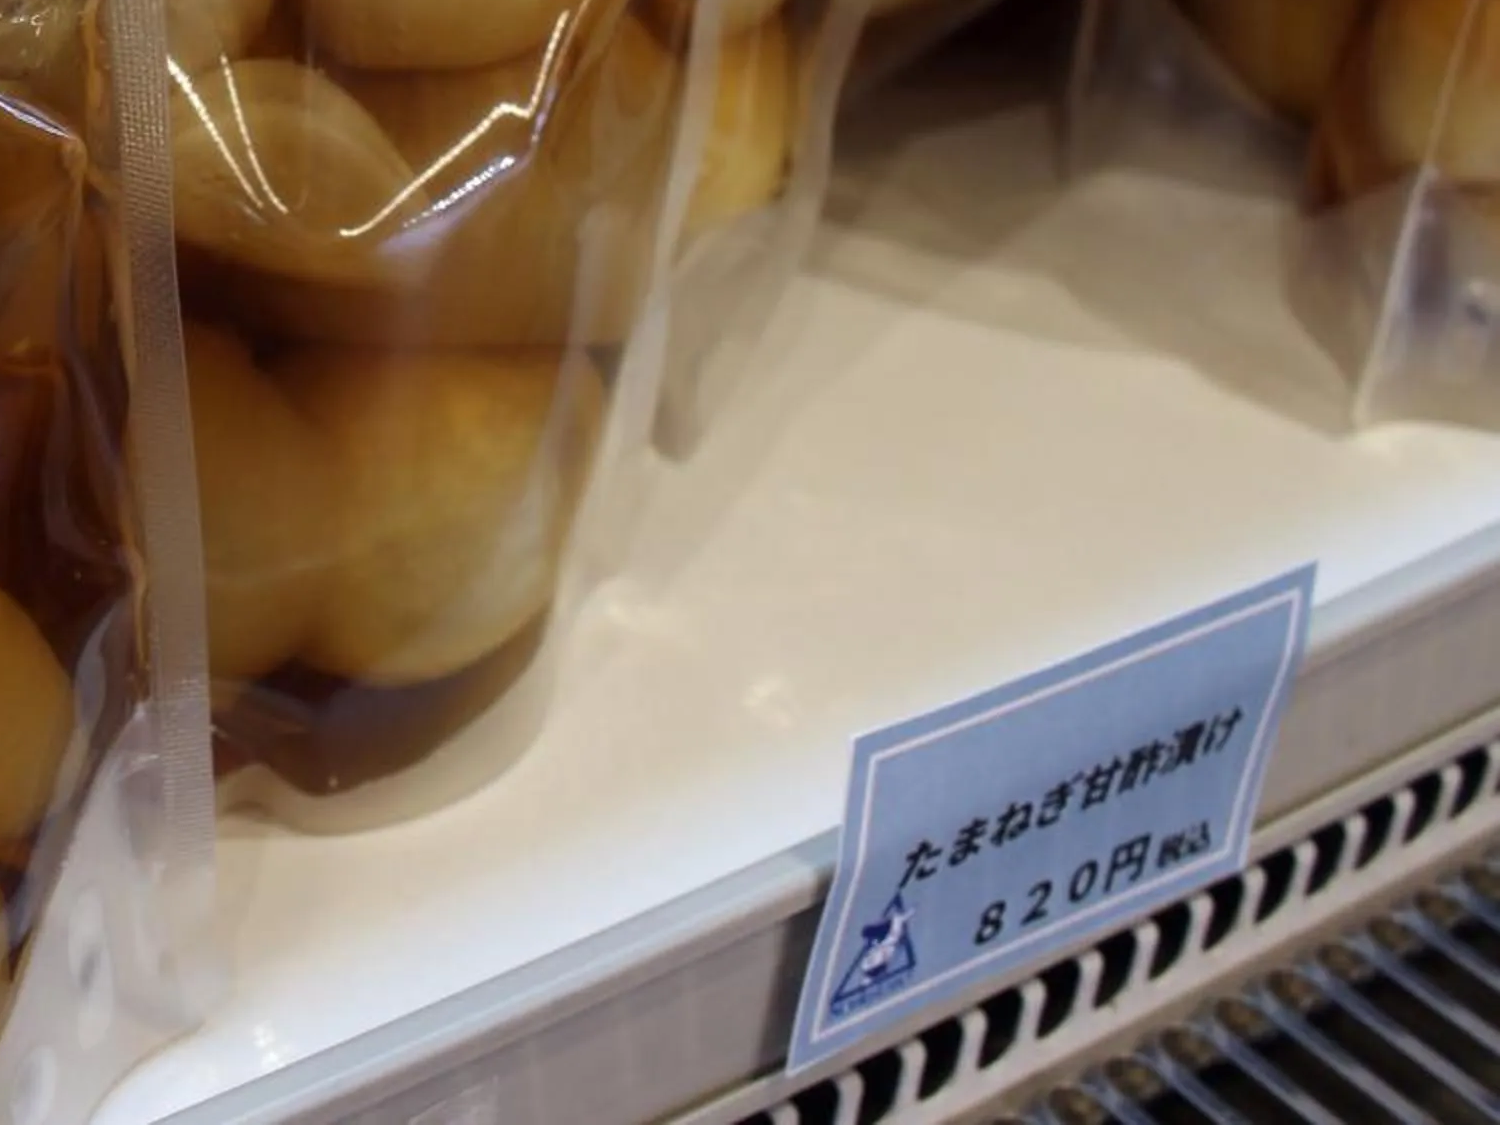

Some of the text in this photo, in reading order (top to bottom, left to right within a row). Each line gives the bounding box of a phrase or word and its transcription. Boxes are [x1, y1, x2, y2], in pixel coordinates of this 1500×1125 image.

[900, 705, 1243, 888] たまねぎ甘酢漬け
